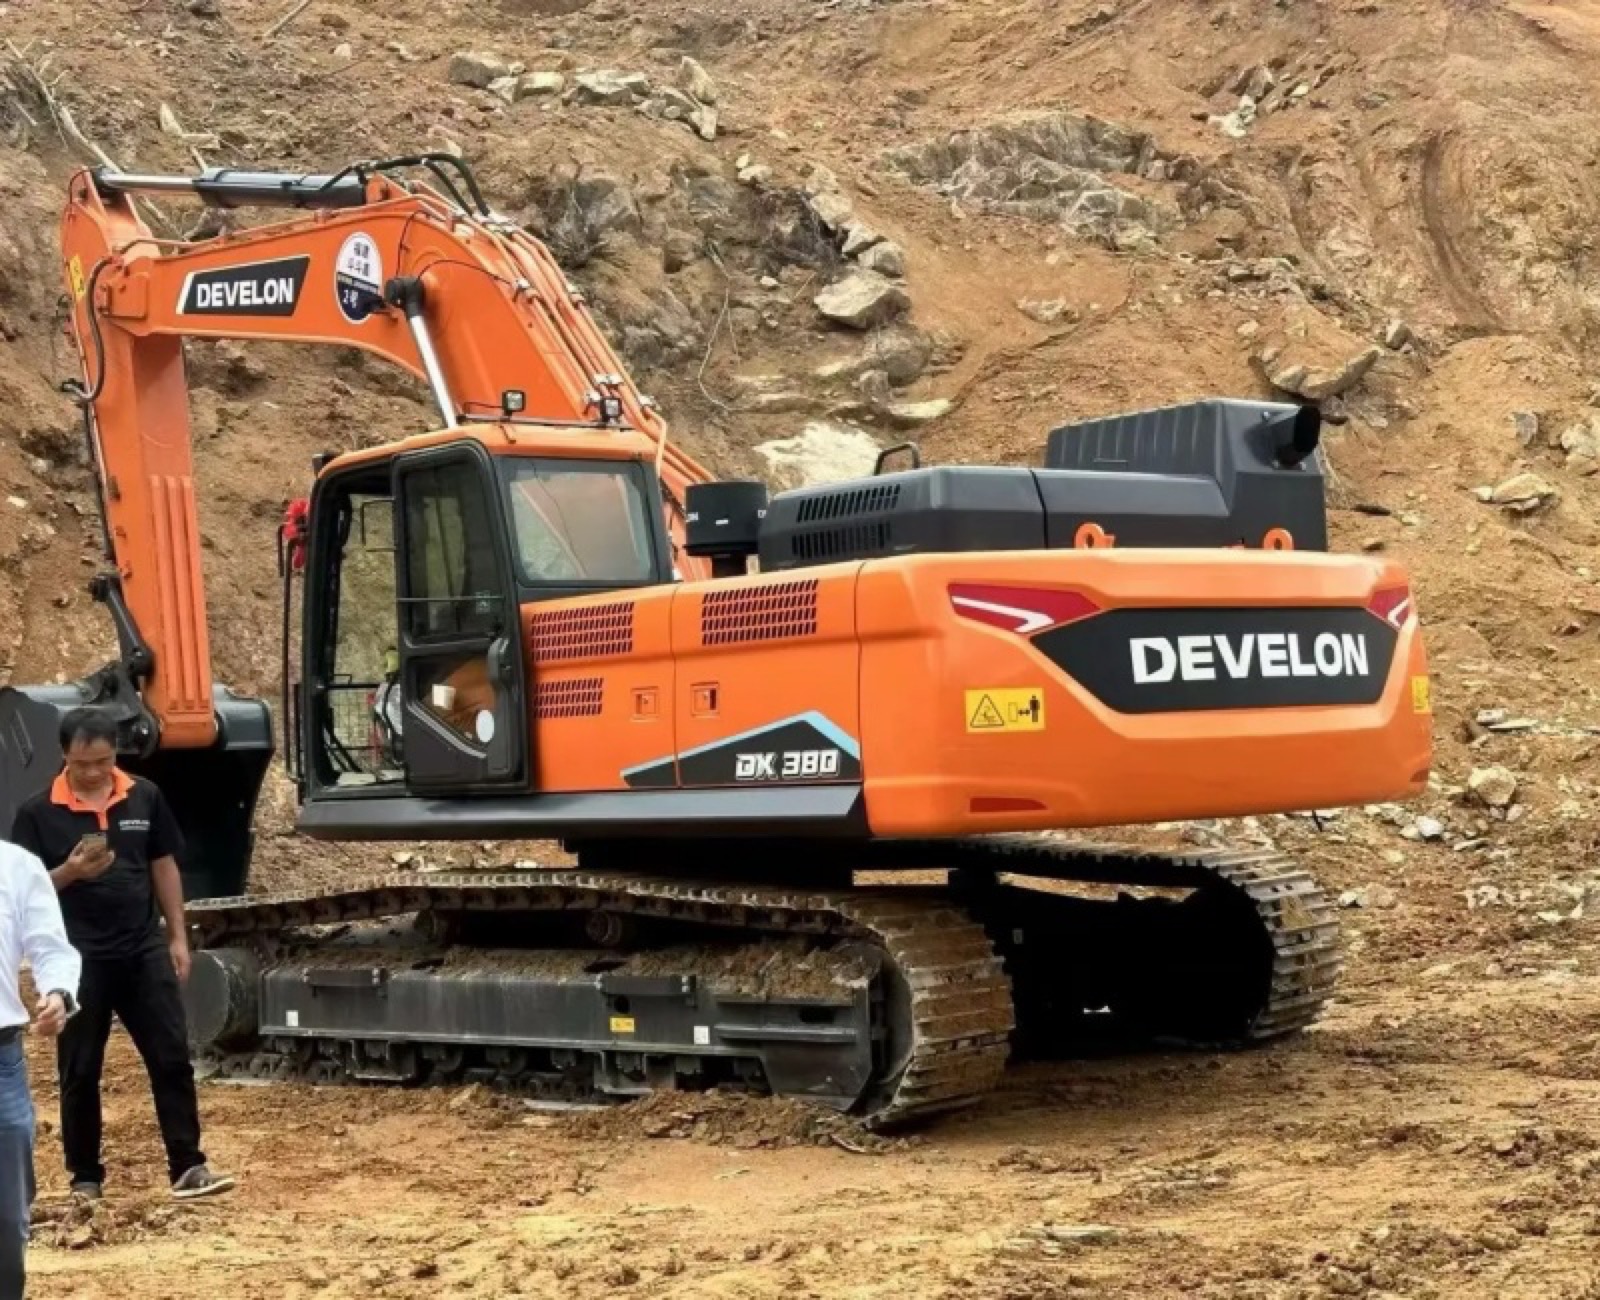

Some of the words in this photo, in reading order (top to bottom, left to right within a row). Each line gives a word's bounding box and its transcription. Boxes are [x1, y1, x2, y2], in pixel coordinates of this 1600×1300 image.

[196, 277, 294, 308] DEVELON
[1130, 633, 1369, 684] DEVELON
[782, 750, 839, 778] 380
